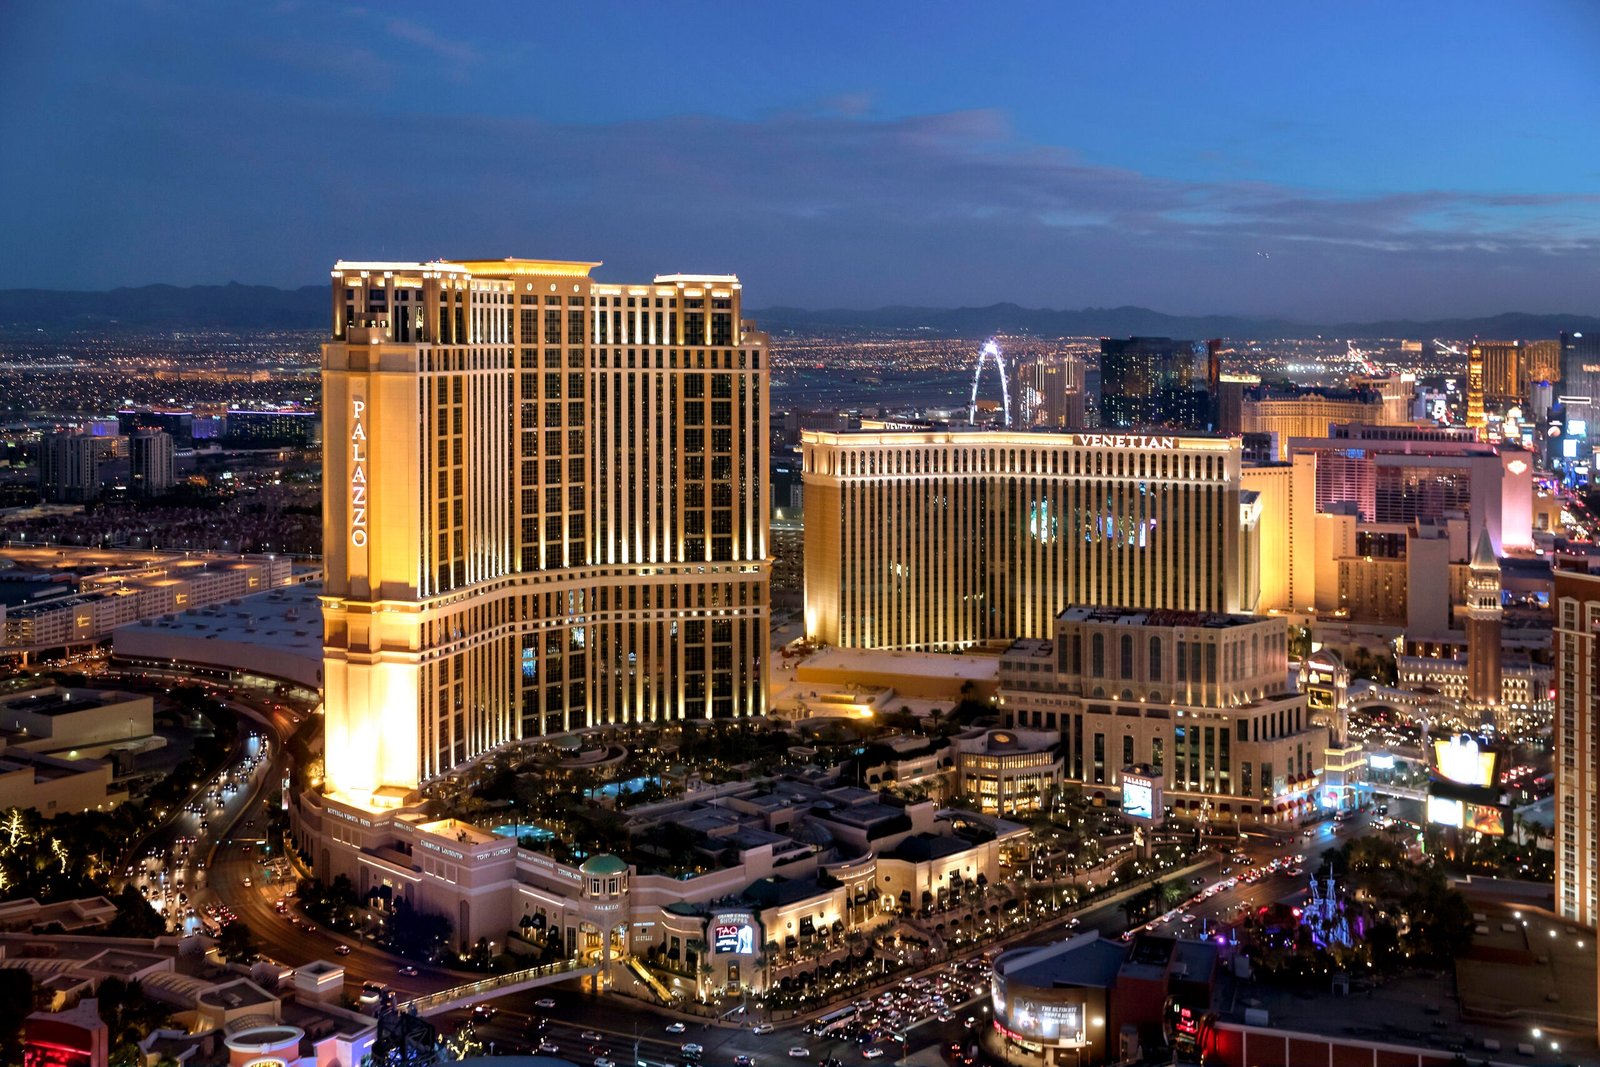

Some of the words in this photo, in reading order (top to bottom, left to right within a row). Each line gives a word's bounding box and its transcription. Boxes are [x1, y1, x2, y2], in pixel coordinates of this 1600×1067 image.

[1078, 434, 1175, 449] VENETIAN
[351, 401, 367, 547] PALAZZO
[1123, 776, 1152, 787] PALAZZO
[716, 925, 738, 937] TAO
